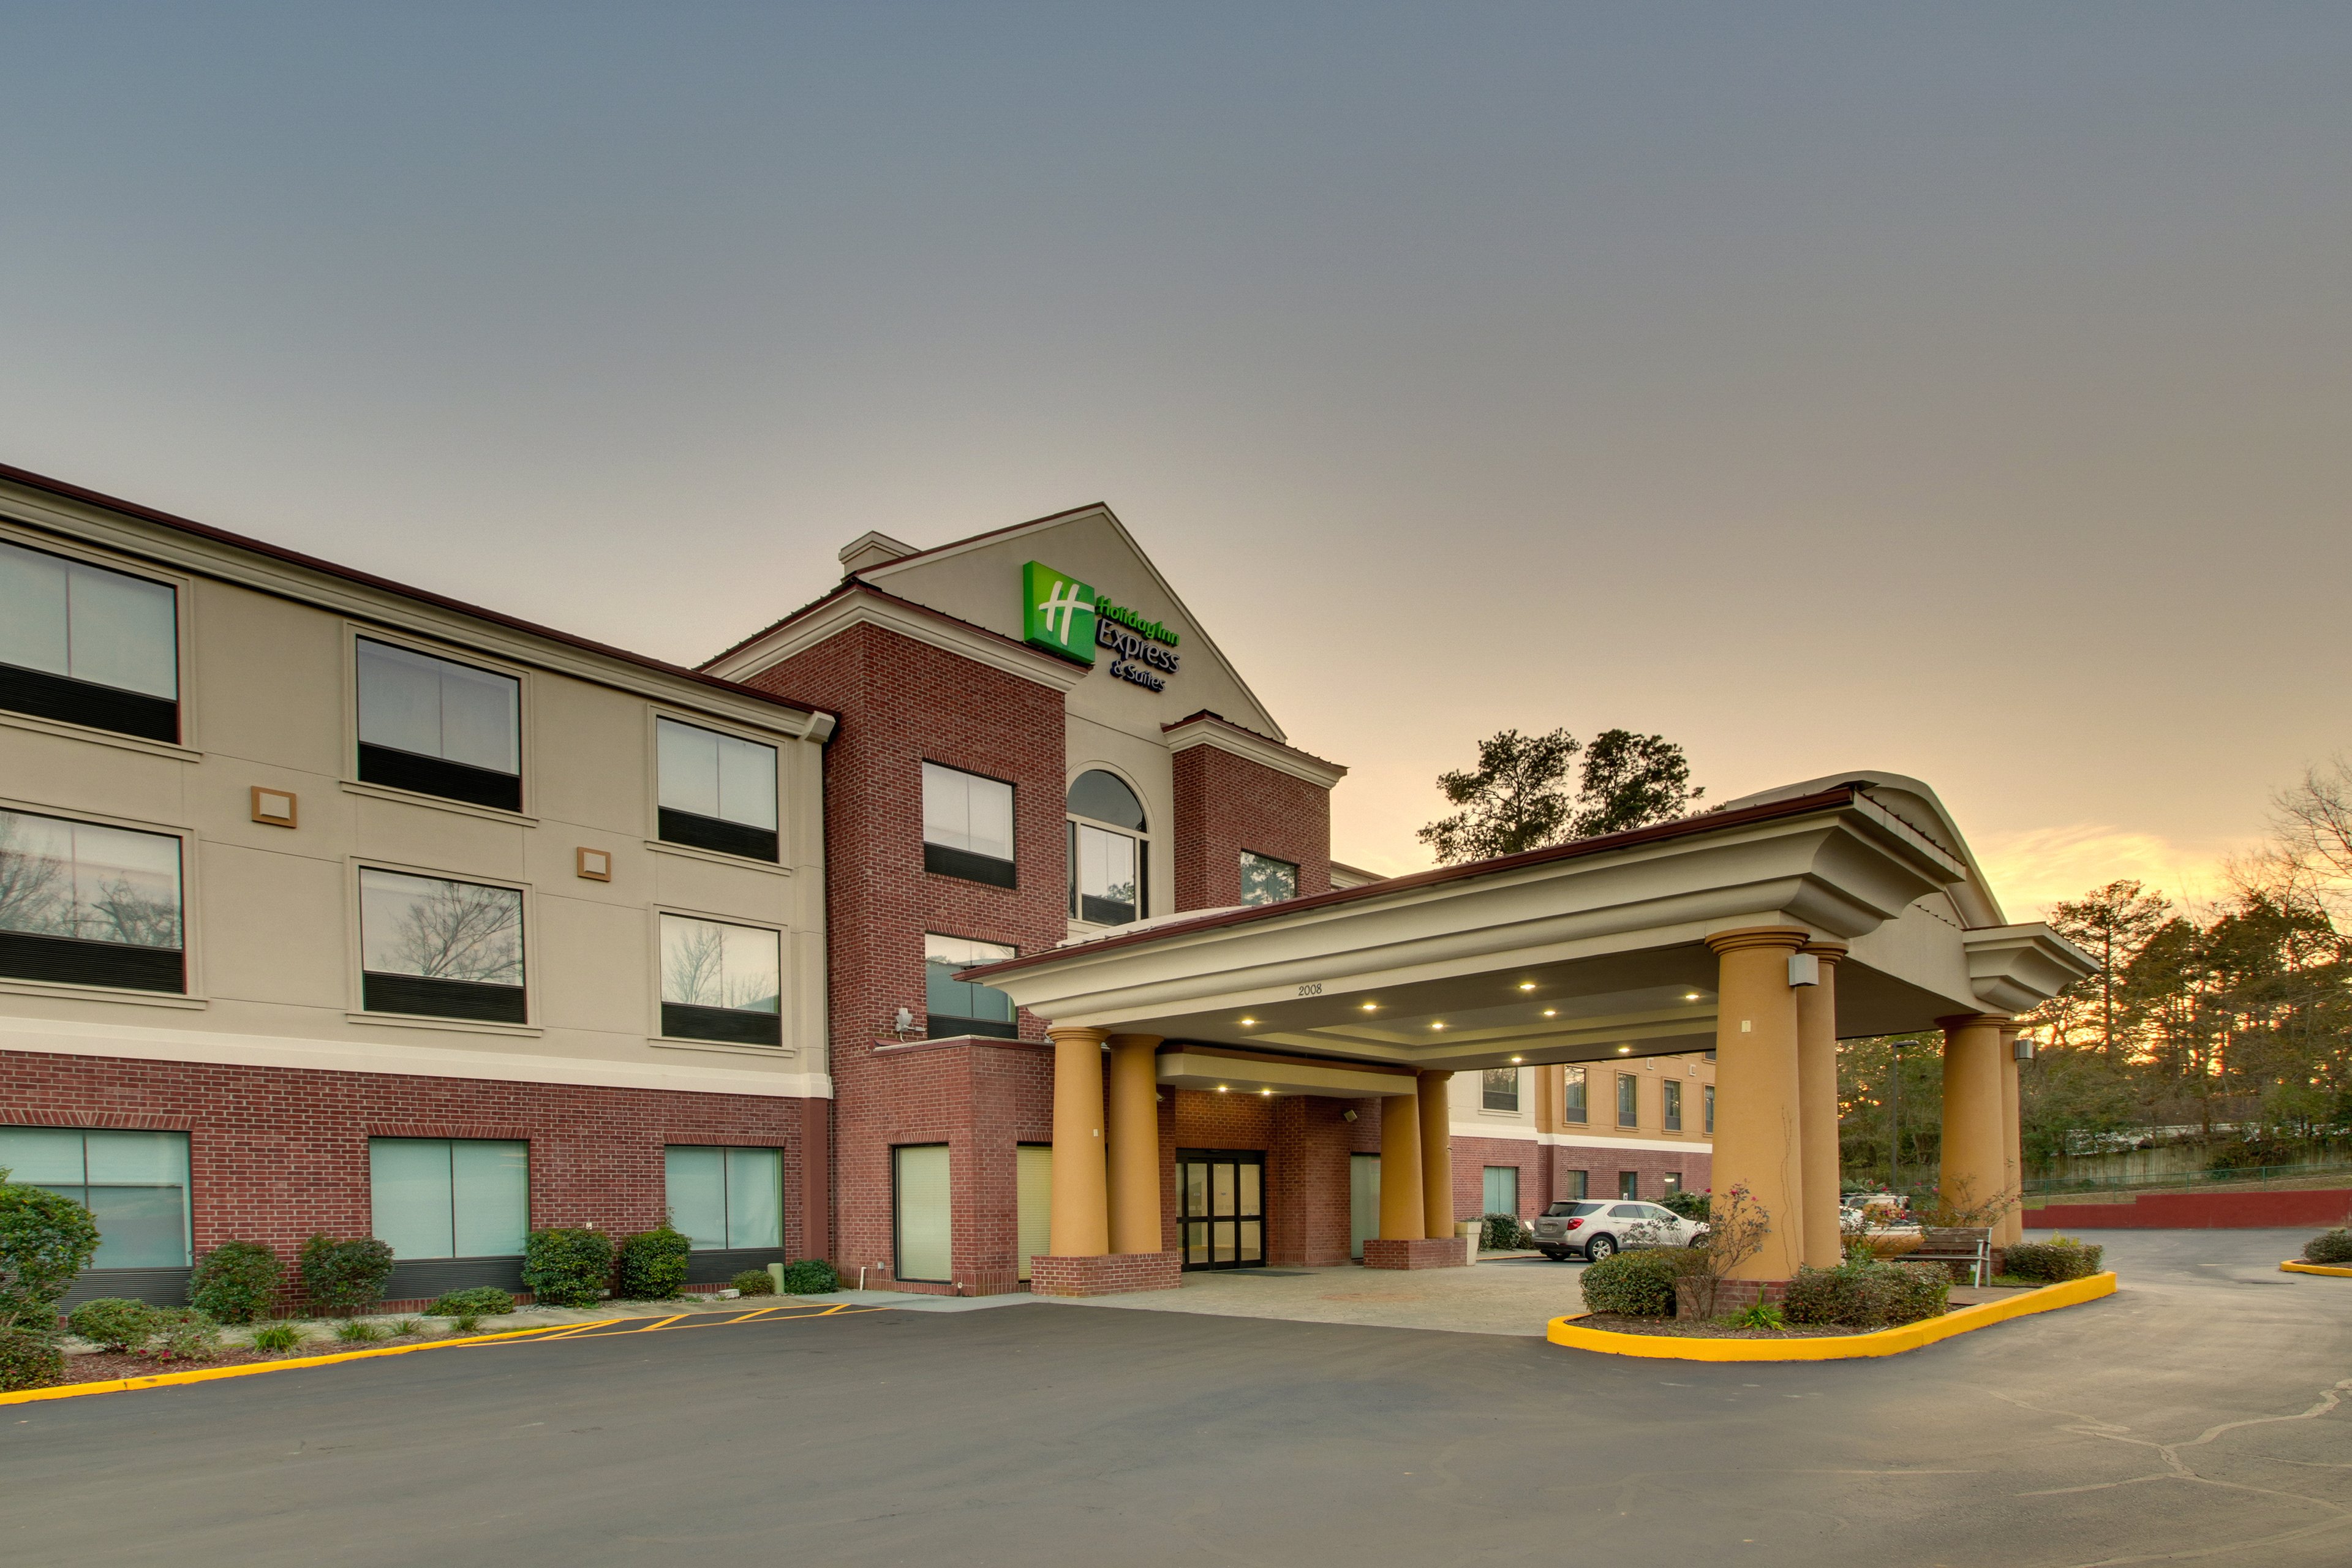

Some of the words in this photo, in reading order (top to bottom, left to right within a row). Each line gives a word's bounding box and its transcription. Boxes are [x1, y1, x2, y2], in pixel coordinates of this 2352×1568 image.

[1098, 595, 1156, 639] Holiday
[1156, 620, 1180, 646] Inn
[1098, 618, 1180, 673] Express
[1112, 659, 1123, 676] &
[1126, 664, 1166, 692] Suites
[1298, 982, 1322, 997] 2008
